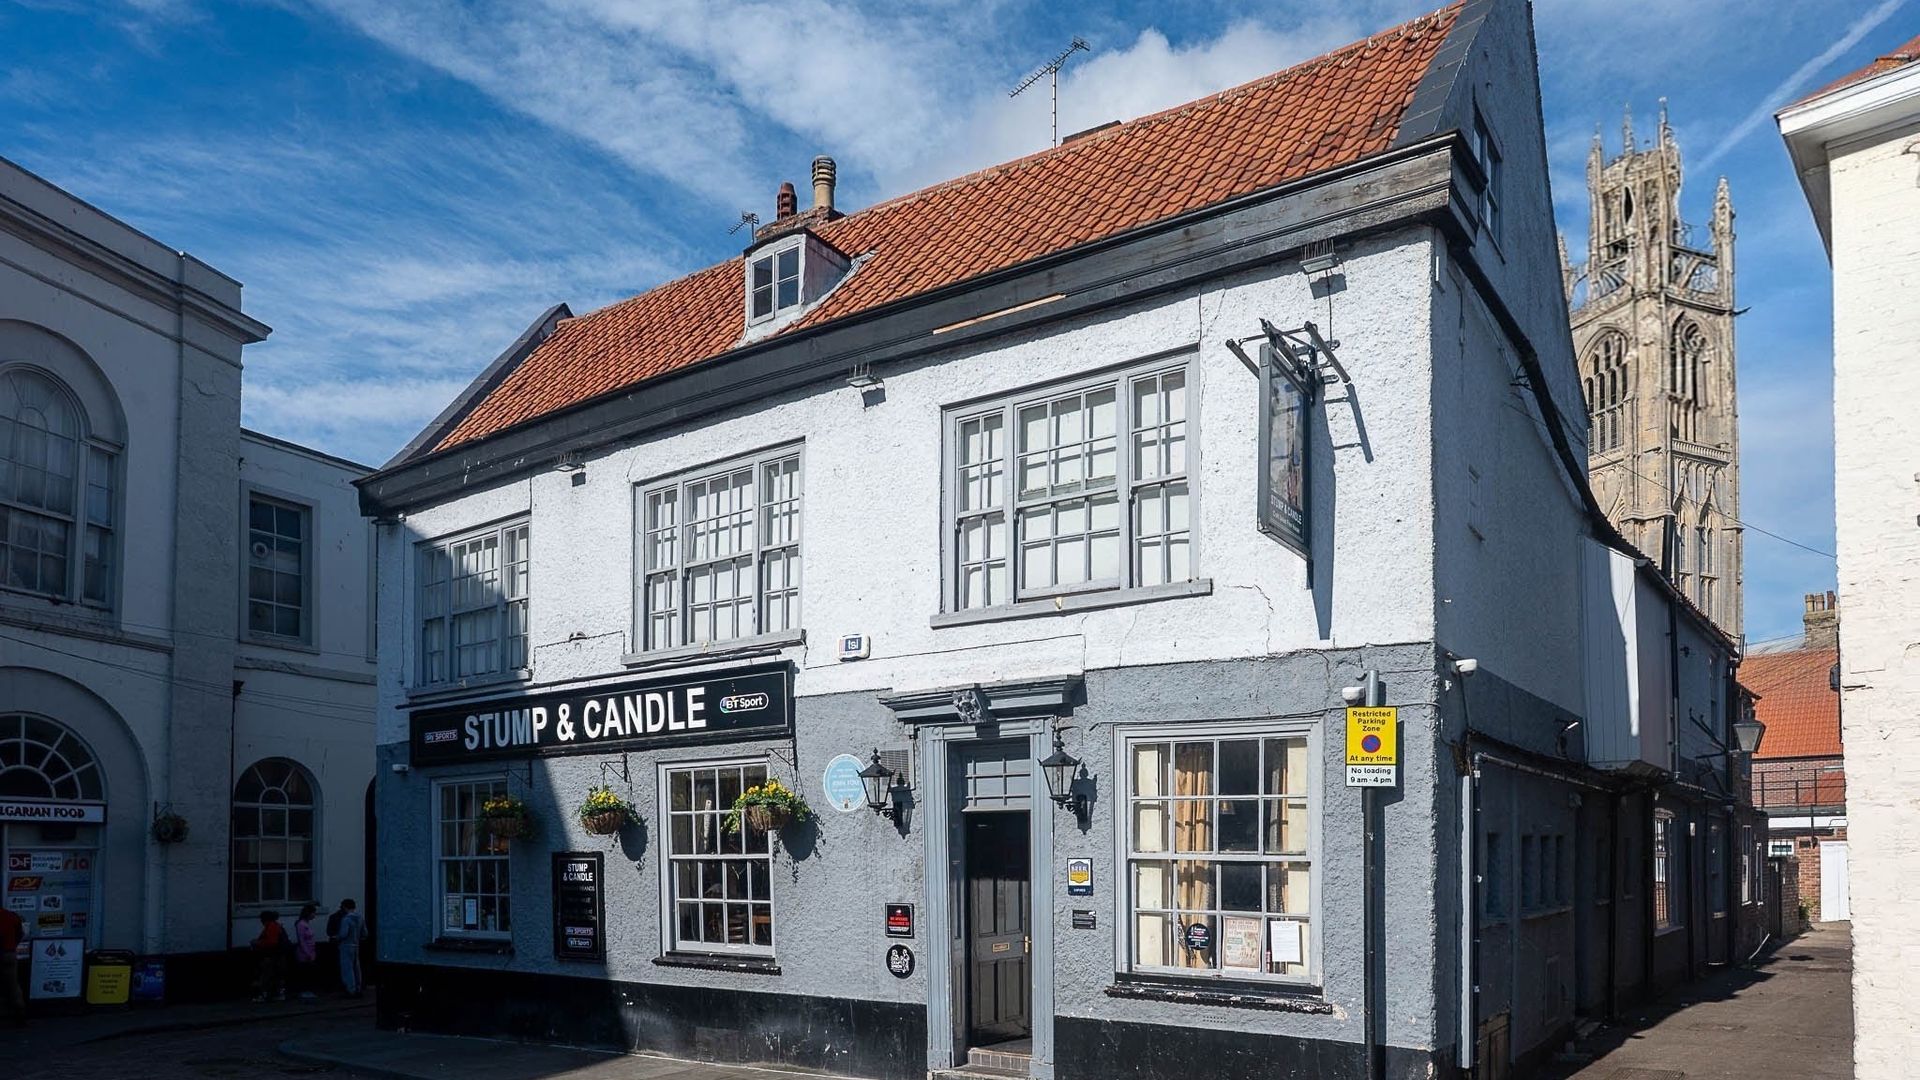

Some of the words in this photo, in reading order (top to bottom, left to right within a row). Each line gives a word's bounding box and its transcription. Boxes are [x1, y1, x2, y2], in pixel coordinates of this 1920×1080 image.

[726, 699, 739, 709] BT
[739, 695, 763, 709] Sport
[464, 706, 548, 751] STUMP
[556, 703, 576, 742] &
[582, 687, 707, 739] CANDLE
[54, 808, 85, 818] FOOD
[567, 863, 588, 872] STUMP
[563, 873, 568, 881] &
[569, 872, 594, 882] CANDLE
